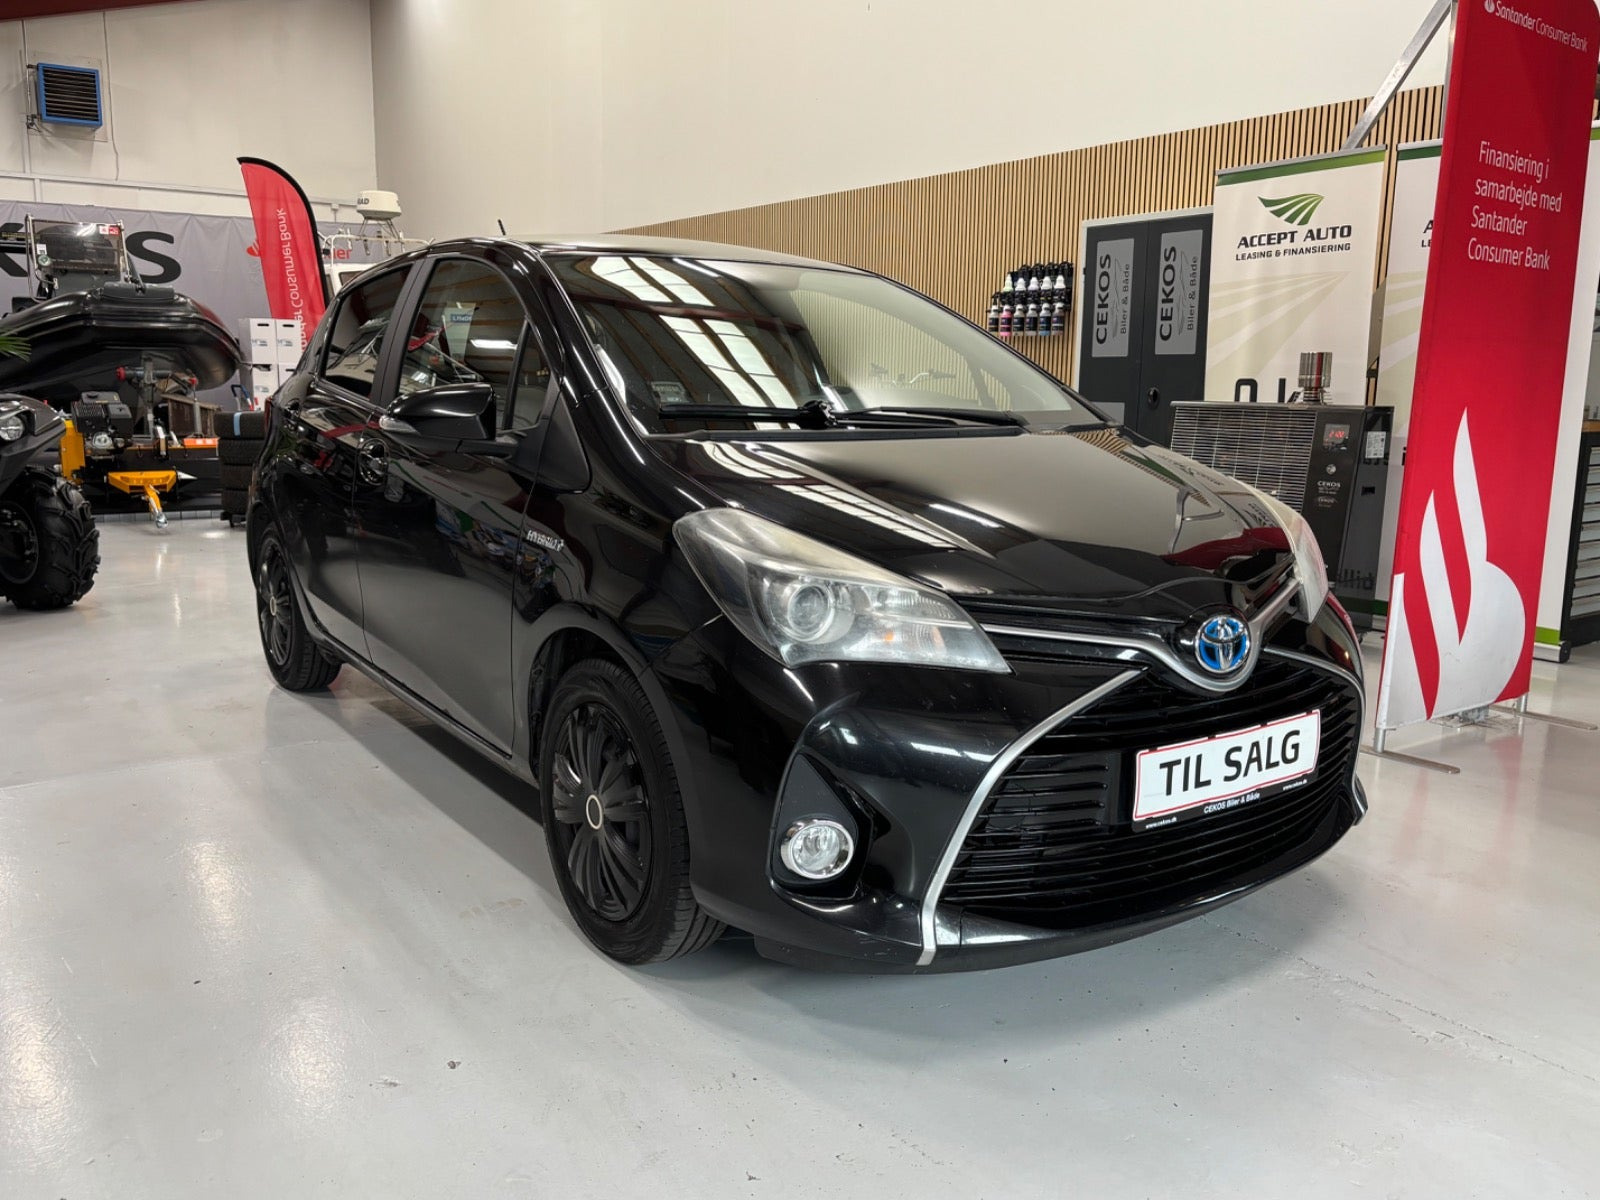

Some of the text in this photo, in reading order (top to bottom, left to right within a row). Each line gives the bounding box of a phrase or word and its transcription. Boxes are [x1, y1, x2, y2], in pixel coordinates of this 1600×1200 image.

[1495, 1, 1588, 52] Santander Consumer Bank
[1478, 140, 1550, 184] Finansiering i
[1475, 178, 1562, 213] samarbejde med
[1237, 225, 1352, 249] ACCEPT AUTO
[1471, 205, 1527, 236] Santander
[1235, 243, 1351, 261] LEASING & FINANSIERING
[1468, 237, 1550, 271] Consumer Bank
[1096, 254, 1111, 344] CEKOS
[1120, 263, 1130, 334] Biler & Både
[1159, 246, 1177, 341] CEKOS
[1187, 256, 1198, 331] Biler & Både
[1159, 730, 1300, 796] TIL SALG
[1203, 801, 1226, 814] CEKOS
[1226, 798, 1240, 809] Biler
